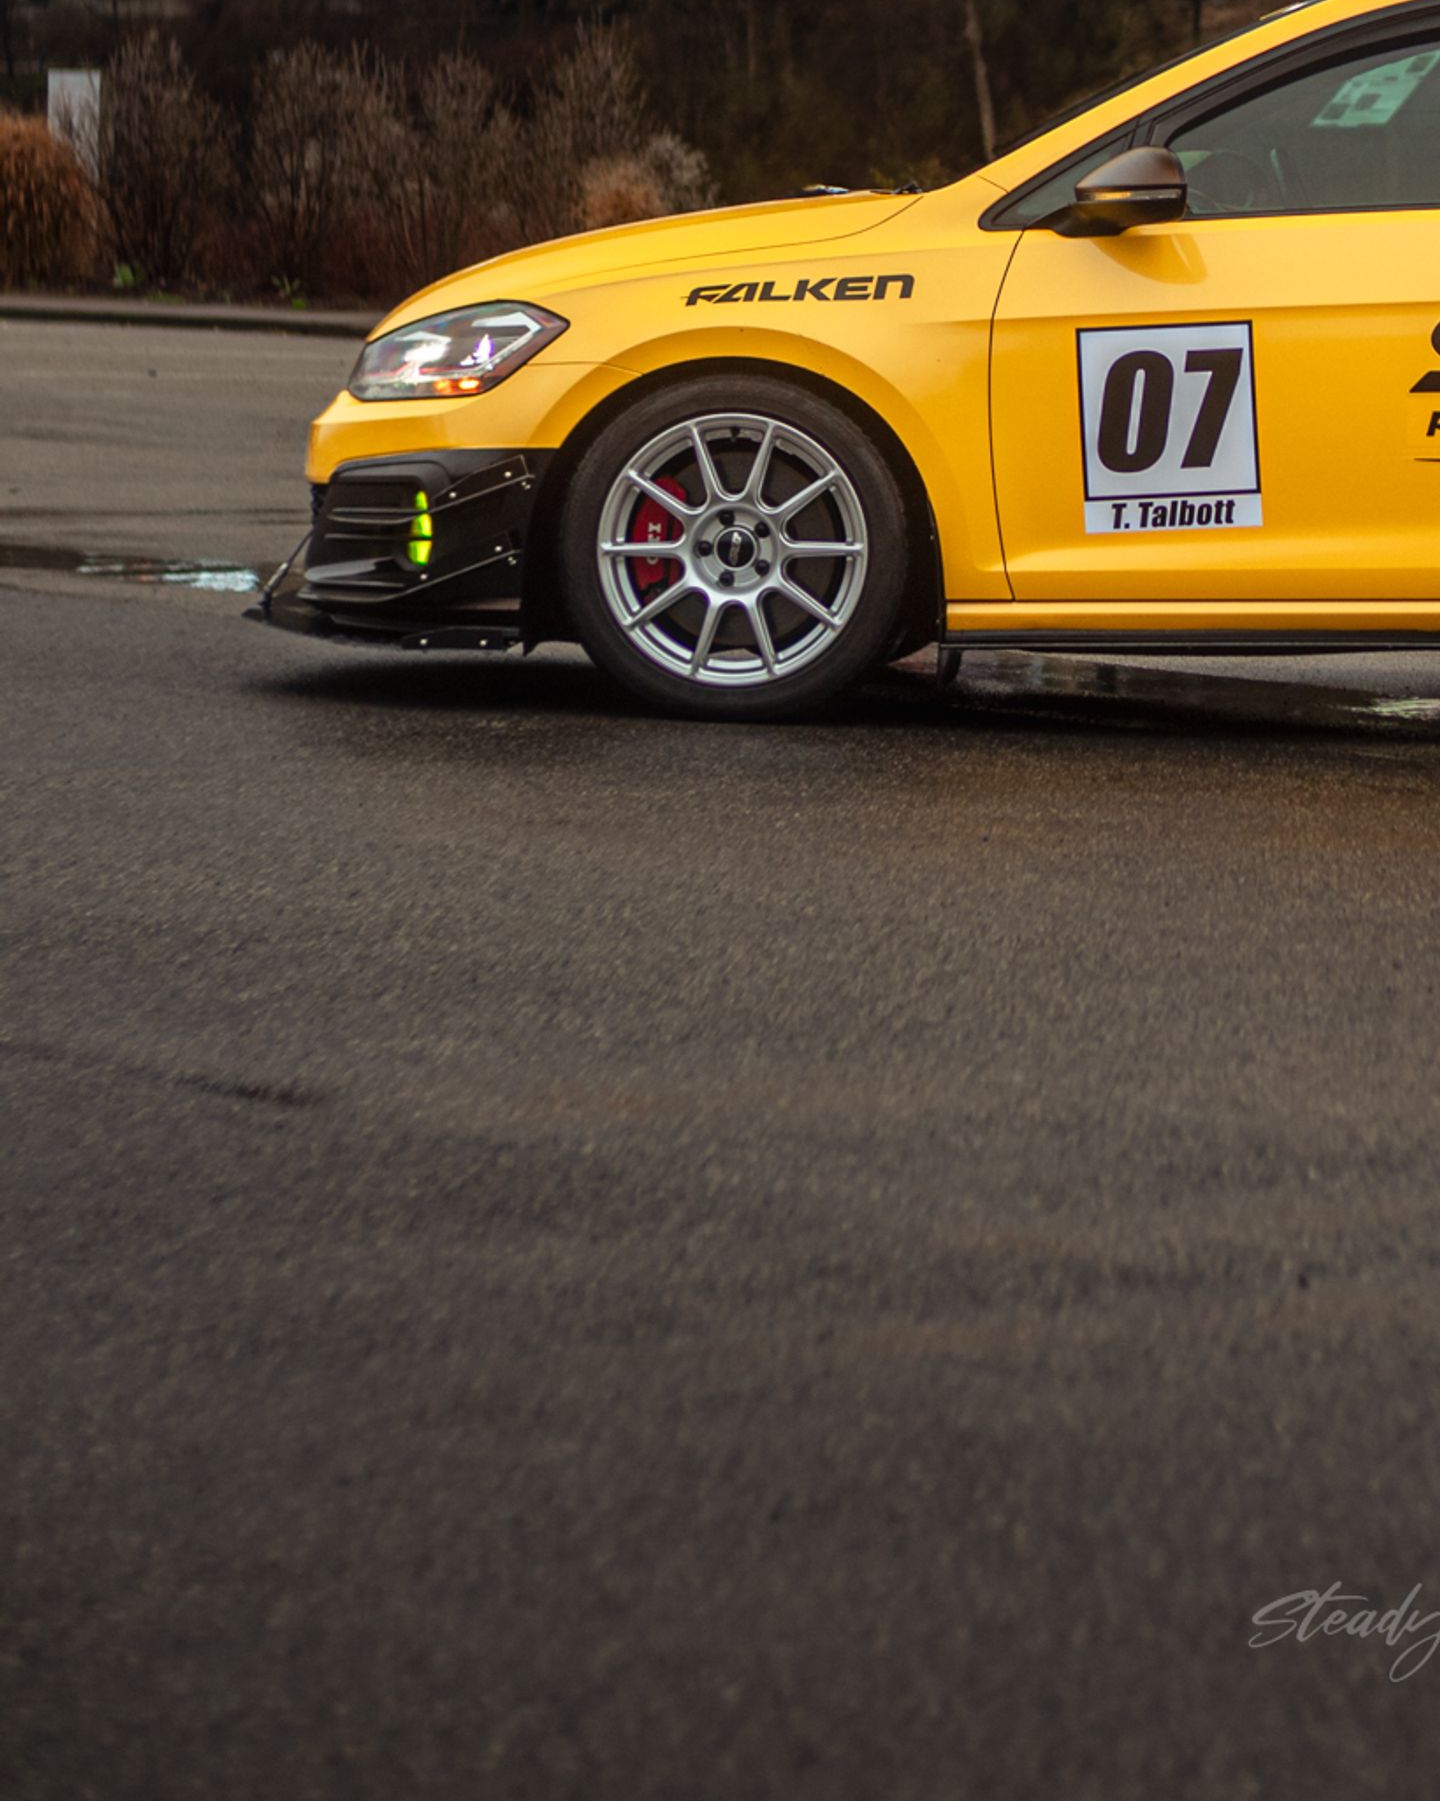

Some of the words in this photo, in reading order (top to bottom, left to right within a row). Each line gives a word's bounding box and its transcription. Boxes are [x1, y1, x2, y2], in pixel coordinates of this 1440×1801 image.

[682, 274, 915, 307] FALKEN
[1097, 347, 1244, 473] 07
[1111, 503, 1131, 530] T.
[1138, 499, 1235, 528] Talbott
